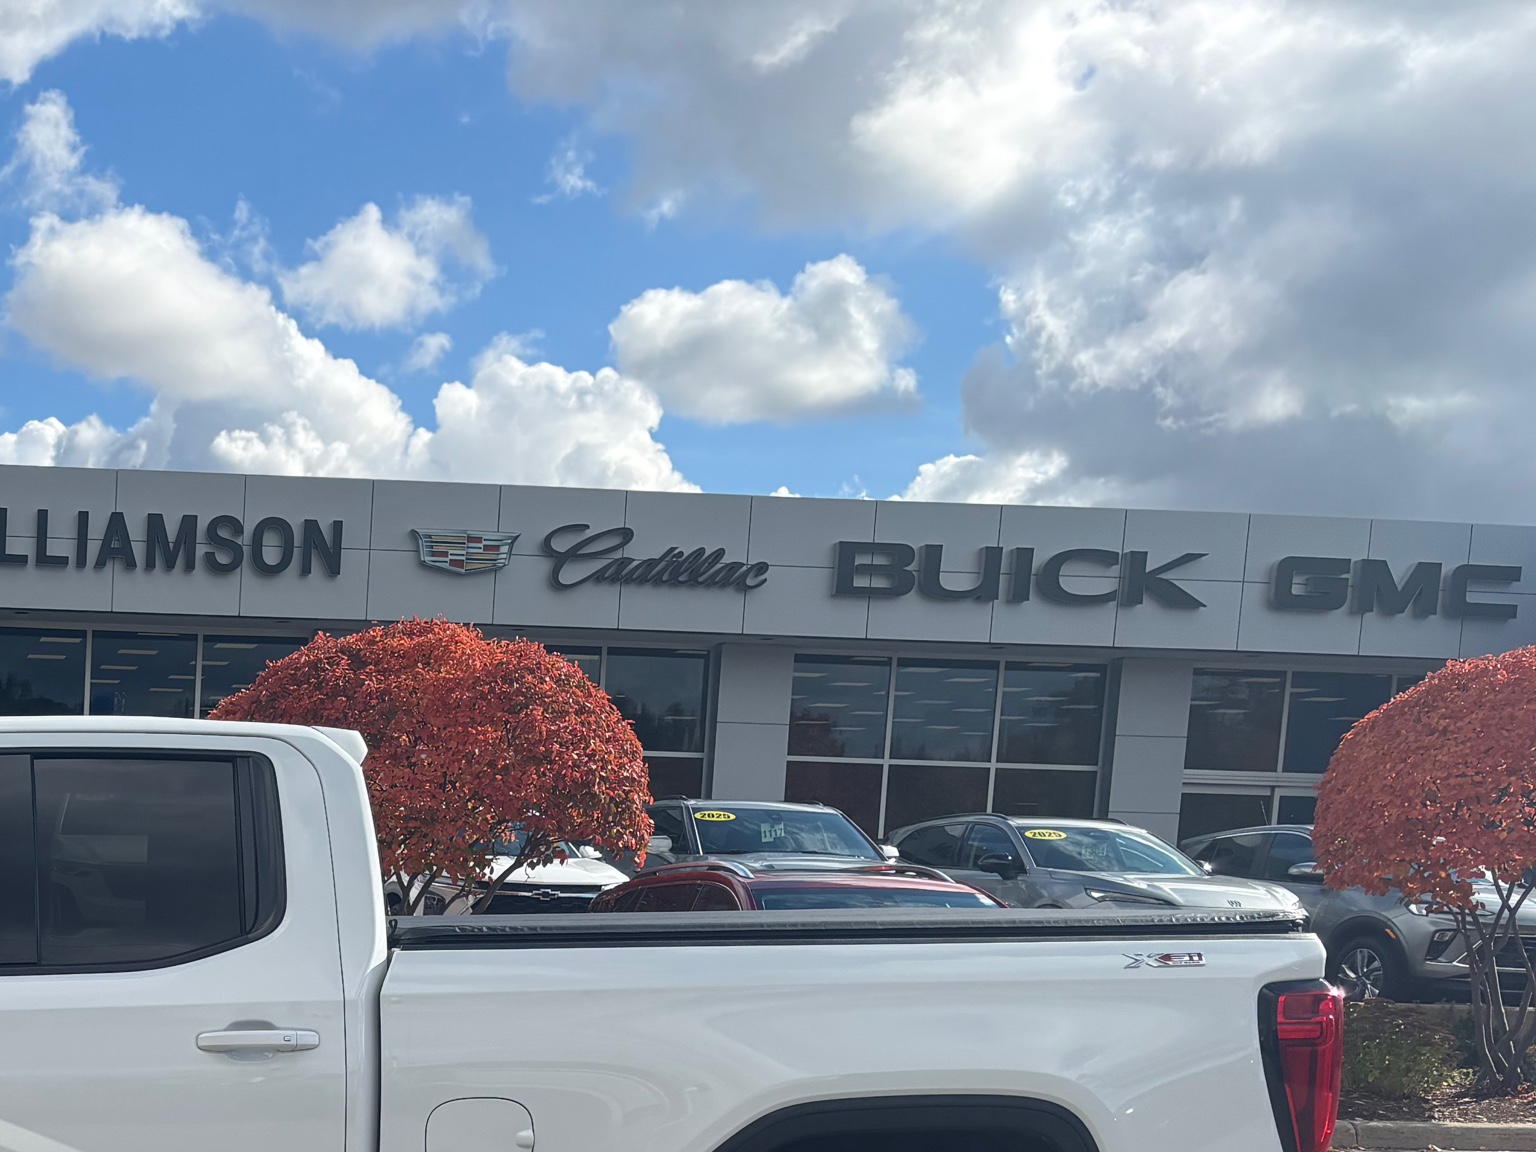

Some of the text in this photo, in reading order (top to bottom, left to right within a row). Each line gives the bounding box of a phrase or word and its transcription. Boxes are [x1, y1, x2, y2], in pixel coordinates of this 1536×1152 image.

[541, 522, 770, 591] Cadillac
[830, 539, 1523, 620] BUICK GMC
[699, 812, 731, 820] 2025
[762, 827, 784, 839] 1117
[1029, 830, 1062, 838] 2025
